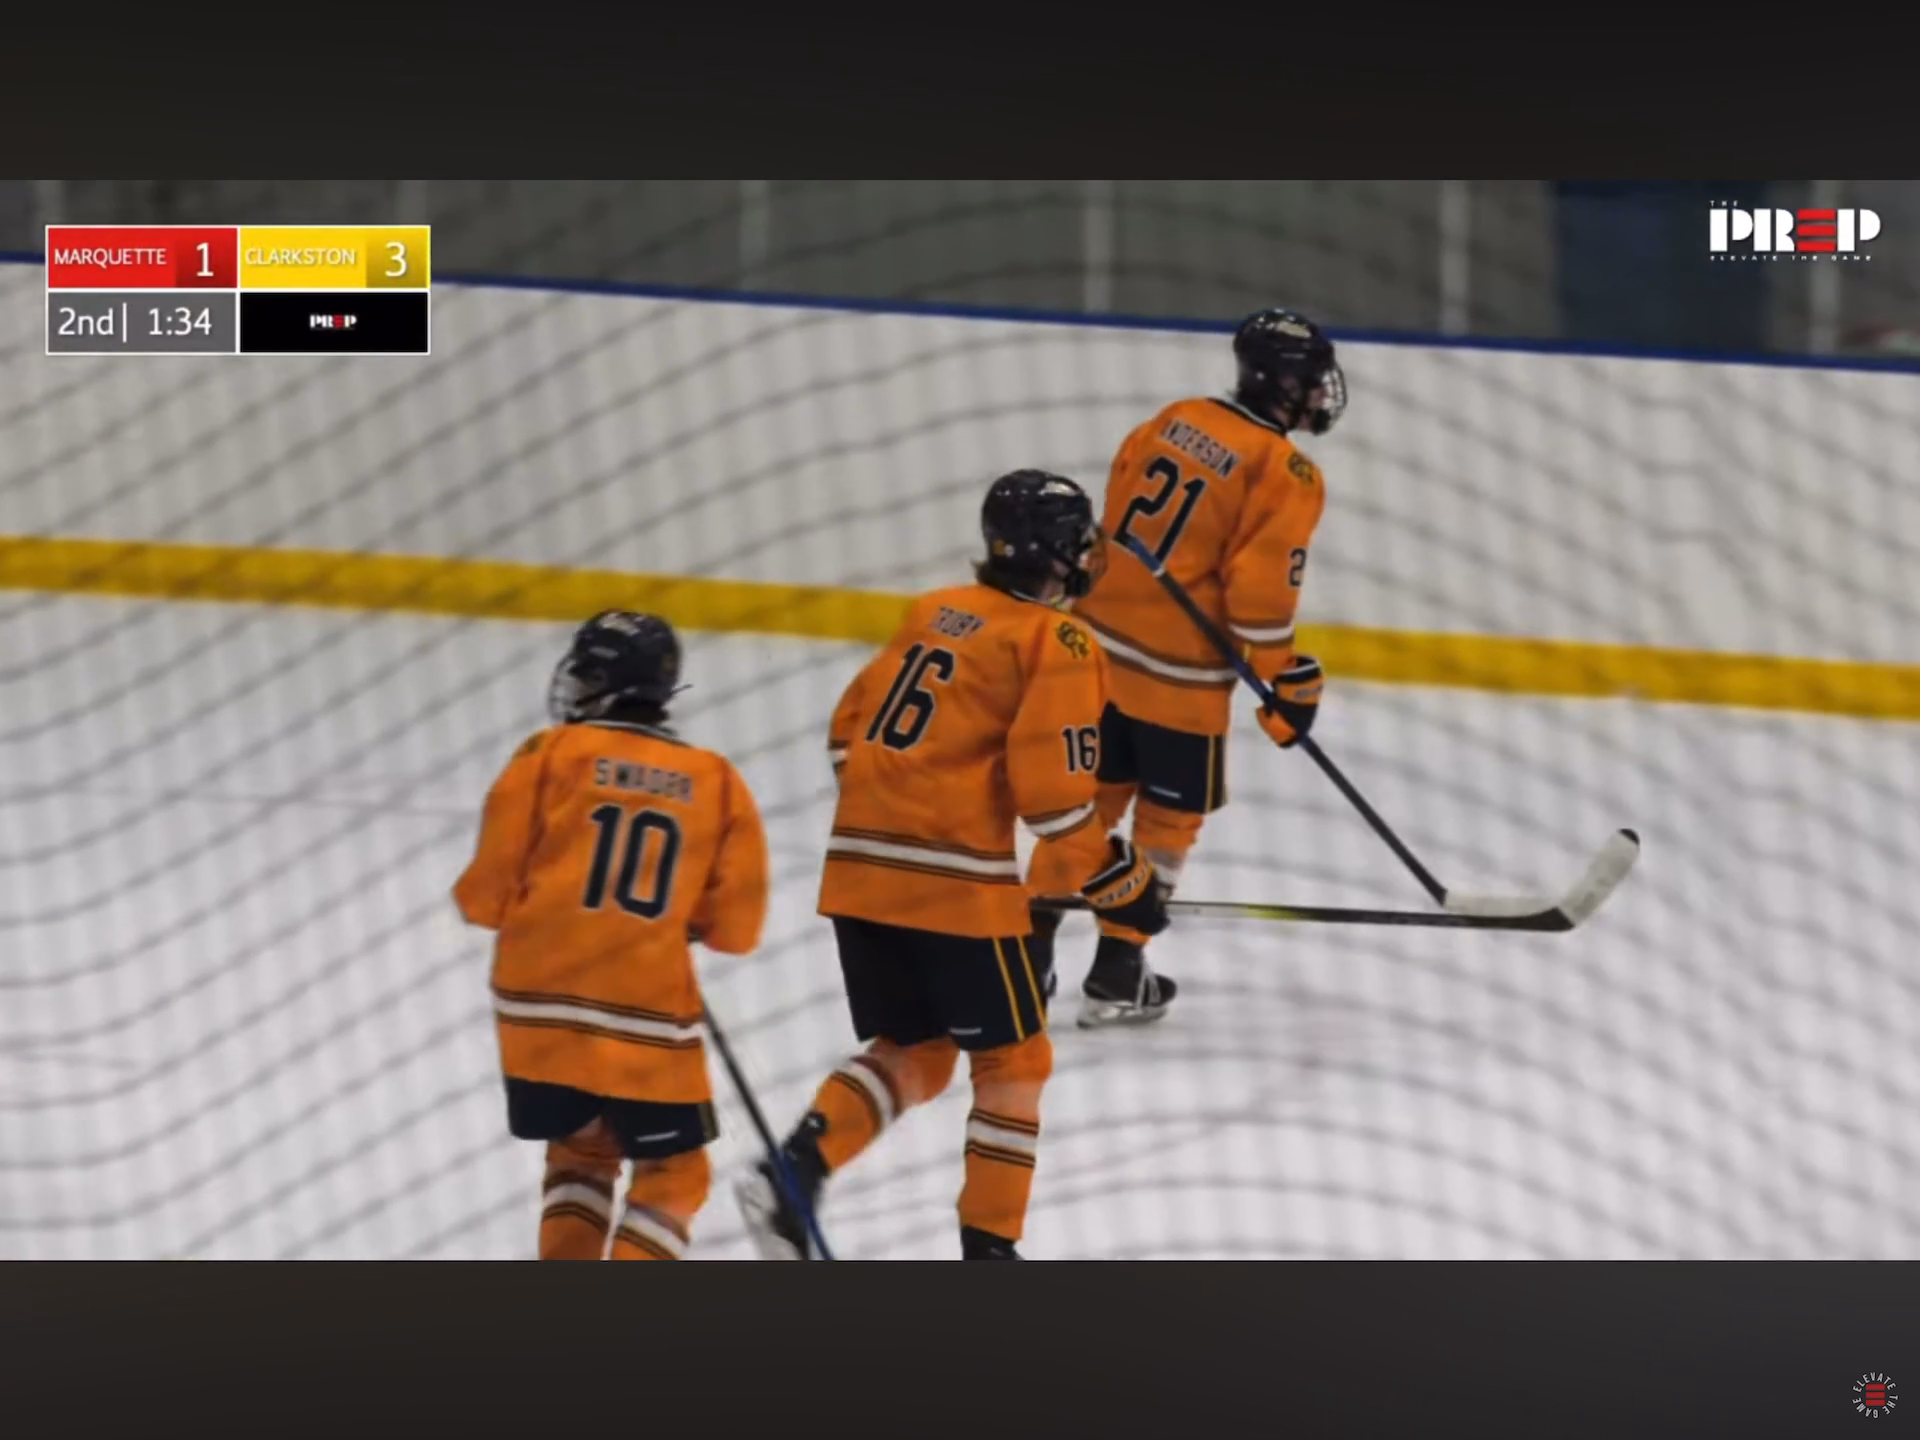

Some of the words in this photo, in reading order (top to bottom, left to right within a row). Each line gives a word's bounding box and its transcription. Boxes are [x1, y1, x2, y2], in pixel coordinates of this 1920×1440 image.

[1112, 455, 1207, 564] 21
[865, 642, 955, 751] 16
[1062, 725, 1098, 774] 16
[582, 803, 683, 921] 10
